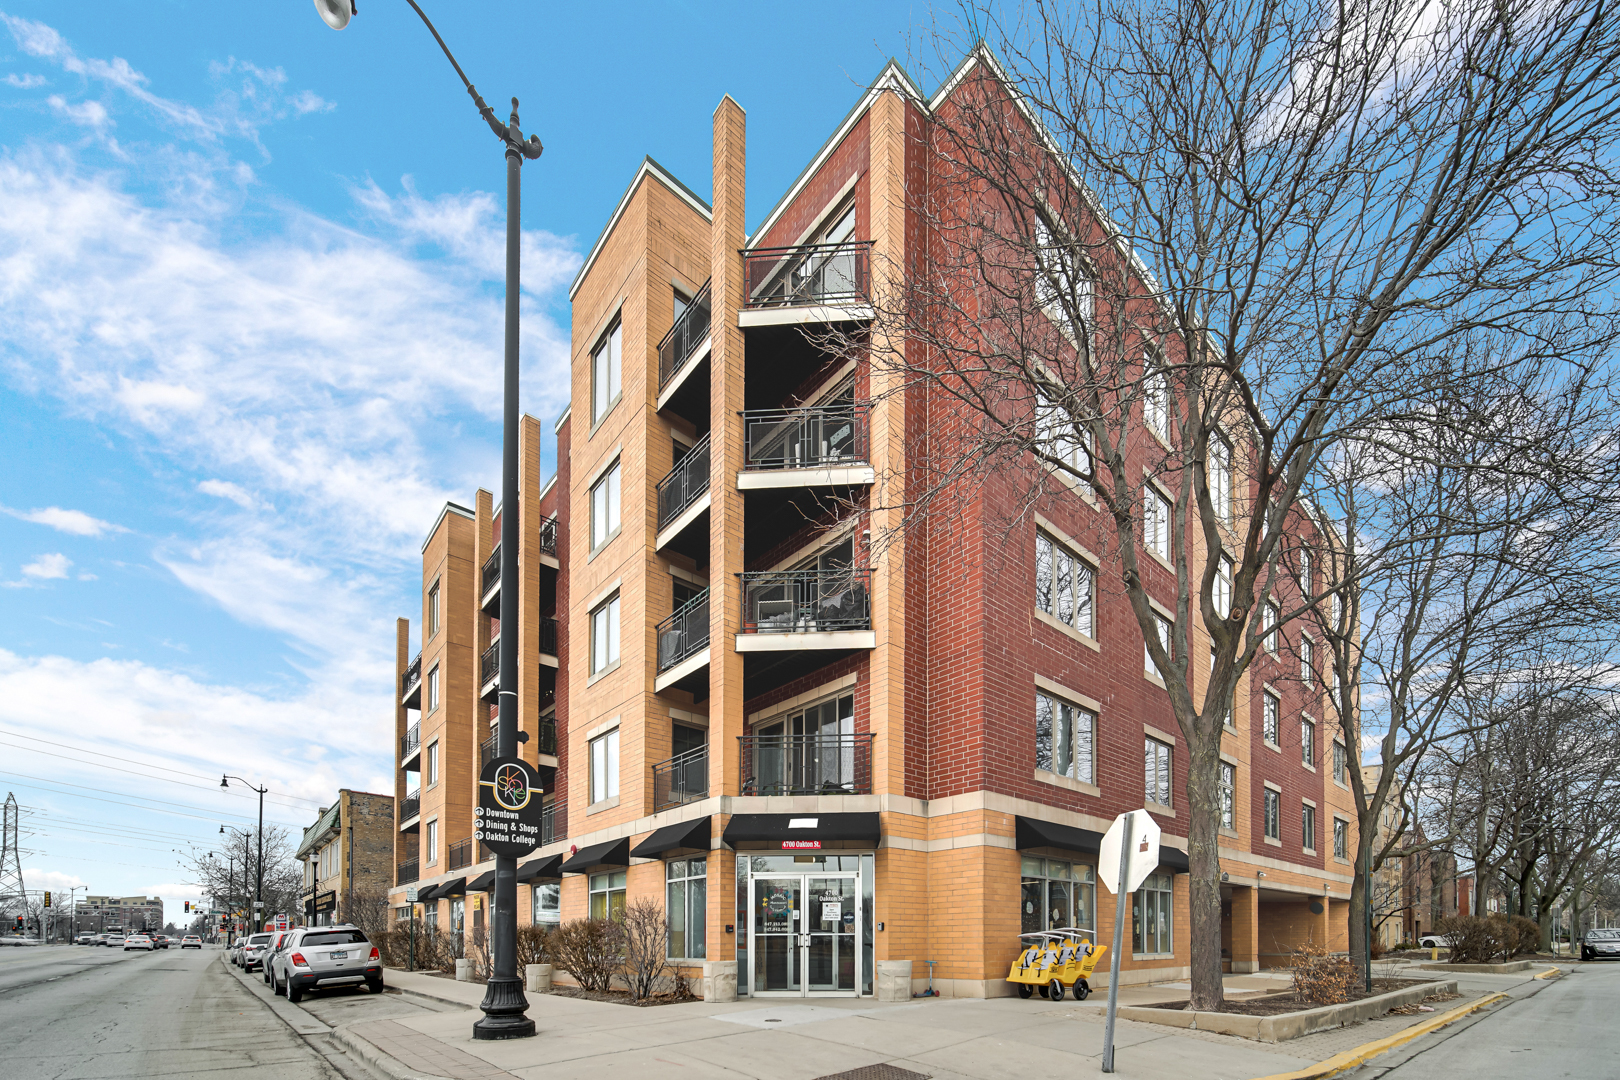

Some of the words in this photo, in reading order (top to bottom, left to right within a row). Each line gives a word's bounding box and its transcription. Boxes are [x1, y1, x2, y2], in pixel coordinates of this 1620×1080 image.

[486, 808, 519, 820] Downtown
[486, 820, 508, 832] Dining
[510, 822, 517, 831] &
[519, 823, 538, 834] Shops
[485, 831, 509, 842] Oakton
[511, 834, 536, 846] College
